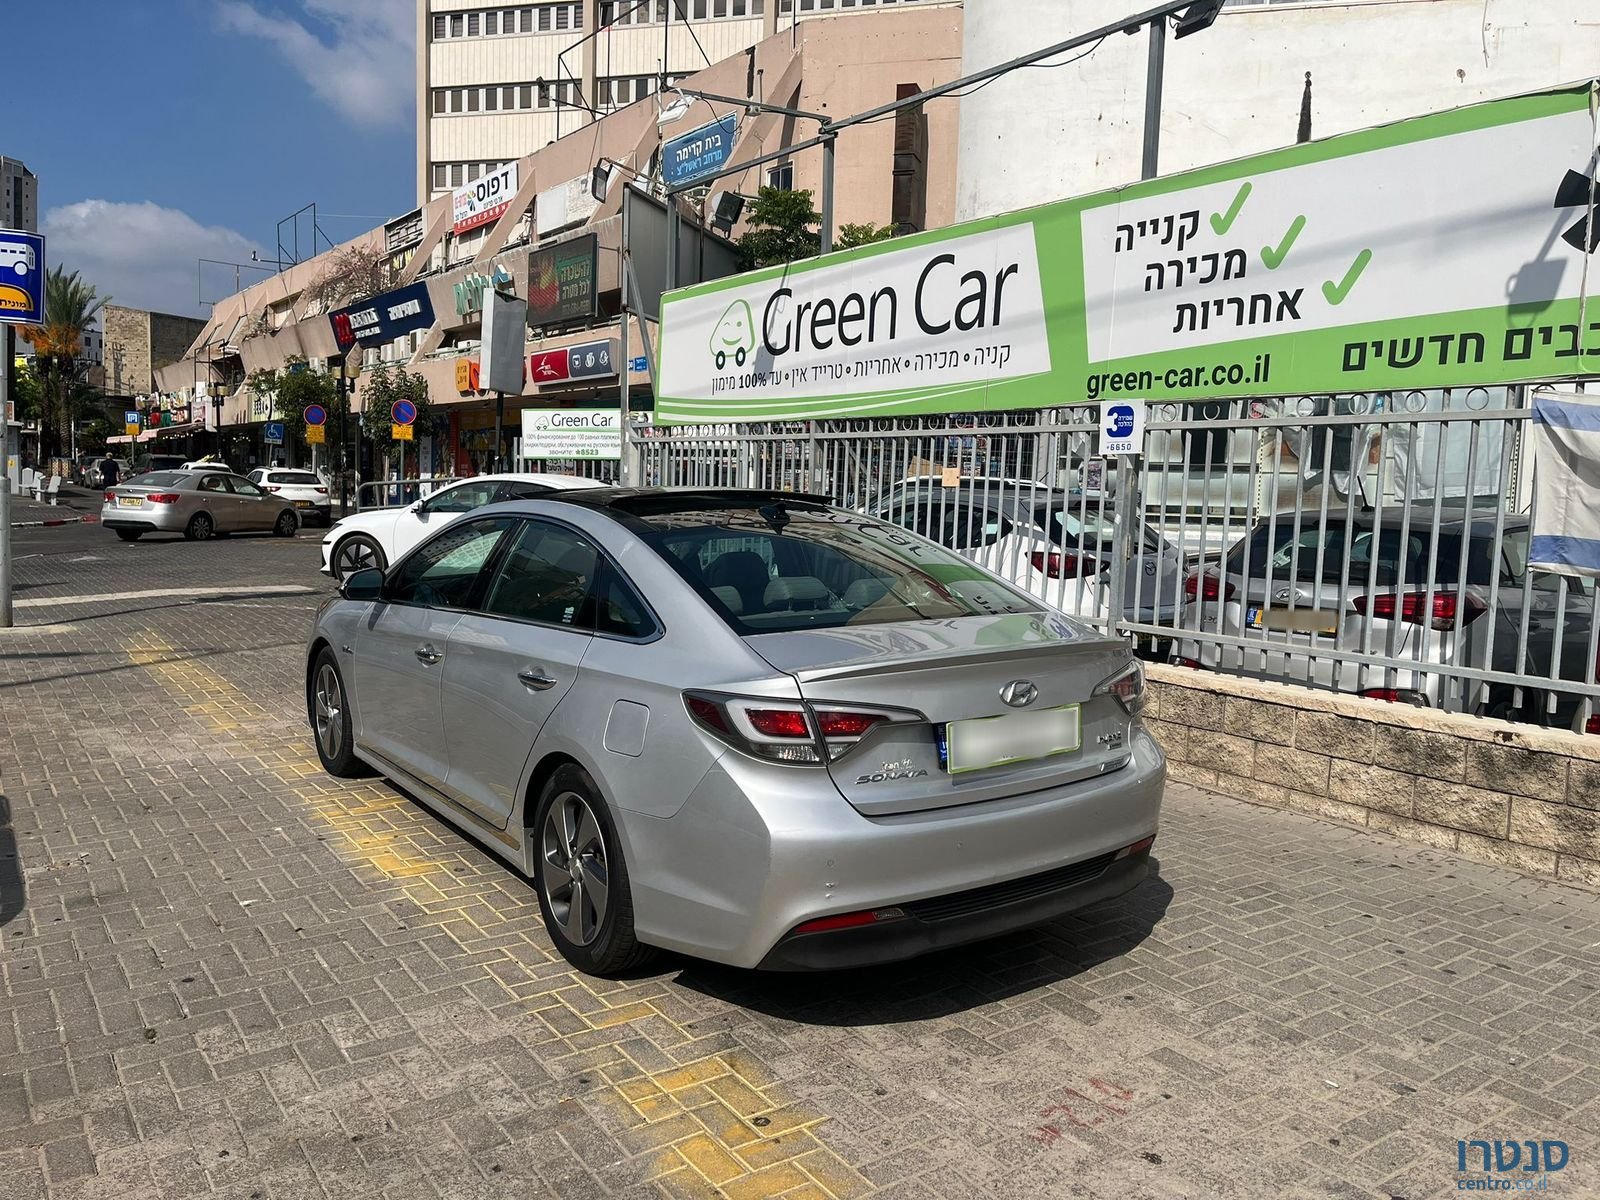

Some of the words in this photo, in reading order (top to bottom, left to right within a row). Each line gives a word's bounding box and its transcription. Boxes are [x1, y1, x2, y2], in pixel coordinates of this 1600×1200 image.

[676, 140, 703, 162] קדימה
[704, 134, 722, 150] בית
[702, 149, 723, 165] מרחב
[476, 170, 509, 202] דפוס
[457, 203, 511, 229] Типографи
[1115, 210, 1200, 253] קנייה
[1144, 248, 1248, 292] מכירה
[762, 286, 897, 356] Green
[914, 253, 1019, 336] Car
[1172, 288, 1305, 334] אחריות
[914, 350, 959, 372] מכירה
[974, 344, 1011, 369] קניה
[1342, 332, 1486, 372] חדשים
[791, 367, 808, 389] אין
[811, 363, 843, 381] טרייד
[853, 356, 902, 378] אחריות
[1086, 353, 1271, 399] green-car.co.il
[711, 375, 736, 396] מימון
[739, 372, 767, 389] 100%
[769, 371, 782, 386] עד
[551, 413, 589, 428] Green
[591, 412, 613, 427] Car
[855, 769, 929, 785] SONATA
